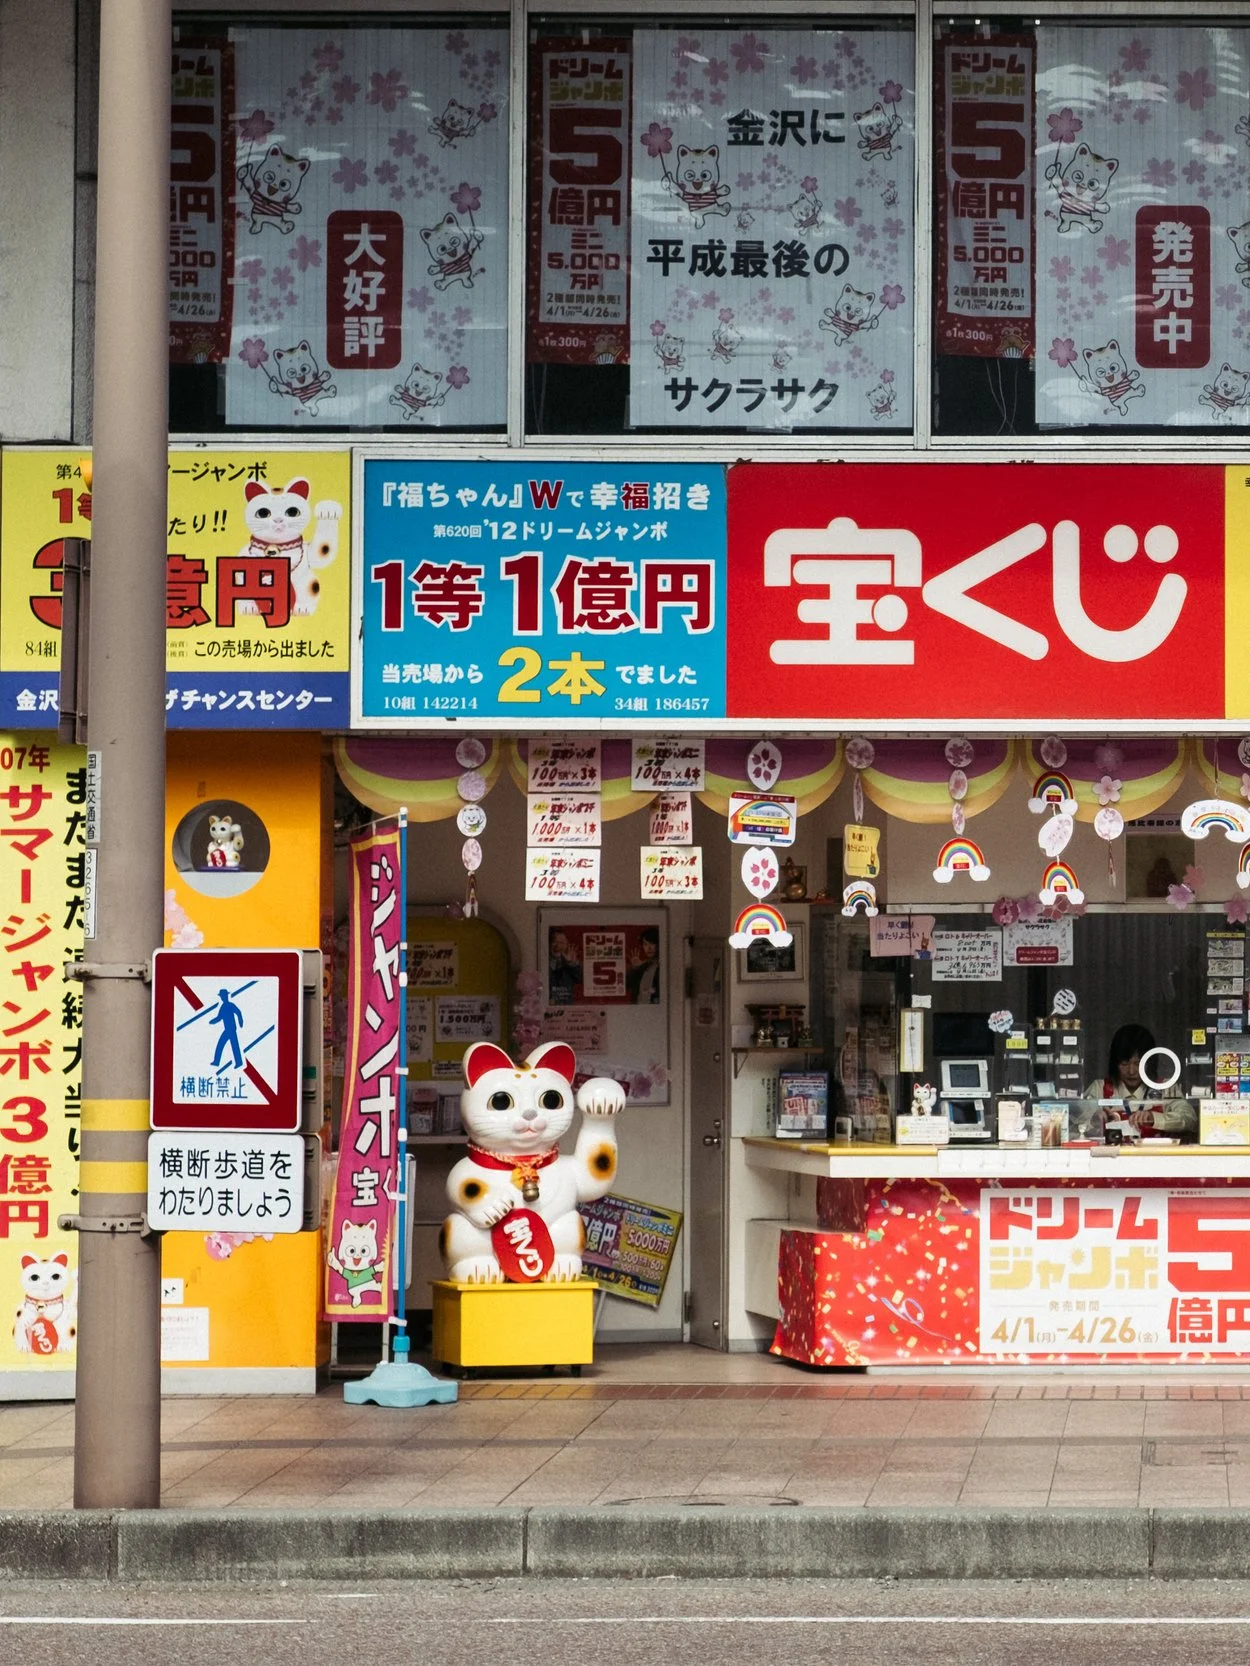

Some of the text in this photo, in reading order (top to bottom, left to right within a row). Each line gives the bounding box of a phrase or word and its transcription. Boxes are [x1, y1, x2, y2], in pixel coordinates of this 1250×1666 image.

[549, 58, 623, 78] ドリーム
[952, 53, 1025, 73] ドリーム
[549, 81, 623, 101] ジャンボ
[952, 75, 1025, 96] ジャンボ
[727, 108, 846, 147] 金沢に
[952, 103, 1025, 178] 5
[549, 108, 622, 184] 5
[548, 187, 621, 226] 億円
[953, 181, 1024, 219] 億円
[571, 232, 603, 249] ミニ
[973, 226, 1007, 243] ミニ
[646, 239, 849, 278] 平成最後の
[342, 223, 387, 358] 大好評
[1152, 221, 1194, 355] 発売中
[664, 377, 839, 412] サクラサク
[168, 462, 267, 482] ージャンボ
[371, 551, 715, 636] 1等 1億円
[763, 516, 1188, 665] 宝くじ
[25, 641, 57, 658] 84組
[194, 640, 335, 659] この売場から出ました
[382, 646, 697, 705] 当売場から 2本 でました
[16, 689, 60, 711] 金沢
[383, 696, 710, 711] 10組 142214 34組 186457
[87, 754, 97, 840] 国土交通省
[593, 961, 616, 985] 5
[180, 1076, 248, 1099] 横断禁止
[159, 1148, 292, 1180] 横断歩道を
[159, 1187, 292, 1218] わたりましょう
[989, 1197, 1158, 1240] ドリーム
[504, 1217, 543, 1277] 宝くじ
[989, 1246, 1159, 1290] ジャンボ
[1049, 1300, 1100, 1312] 発売期間
